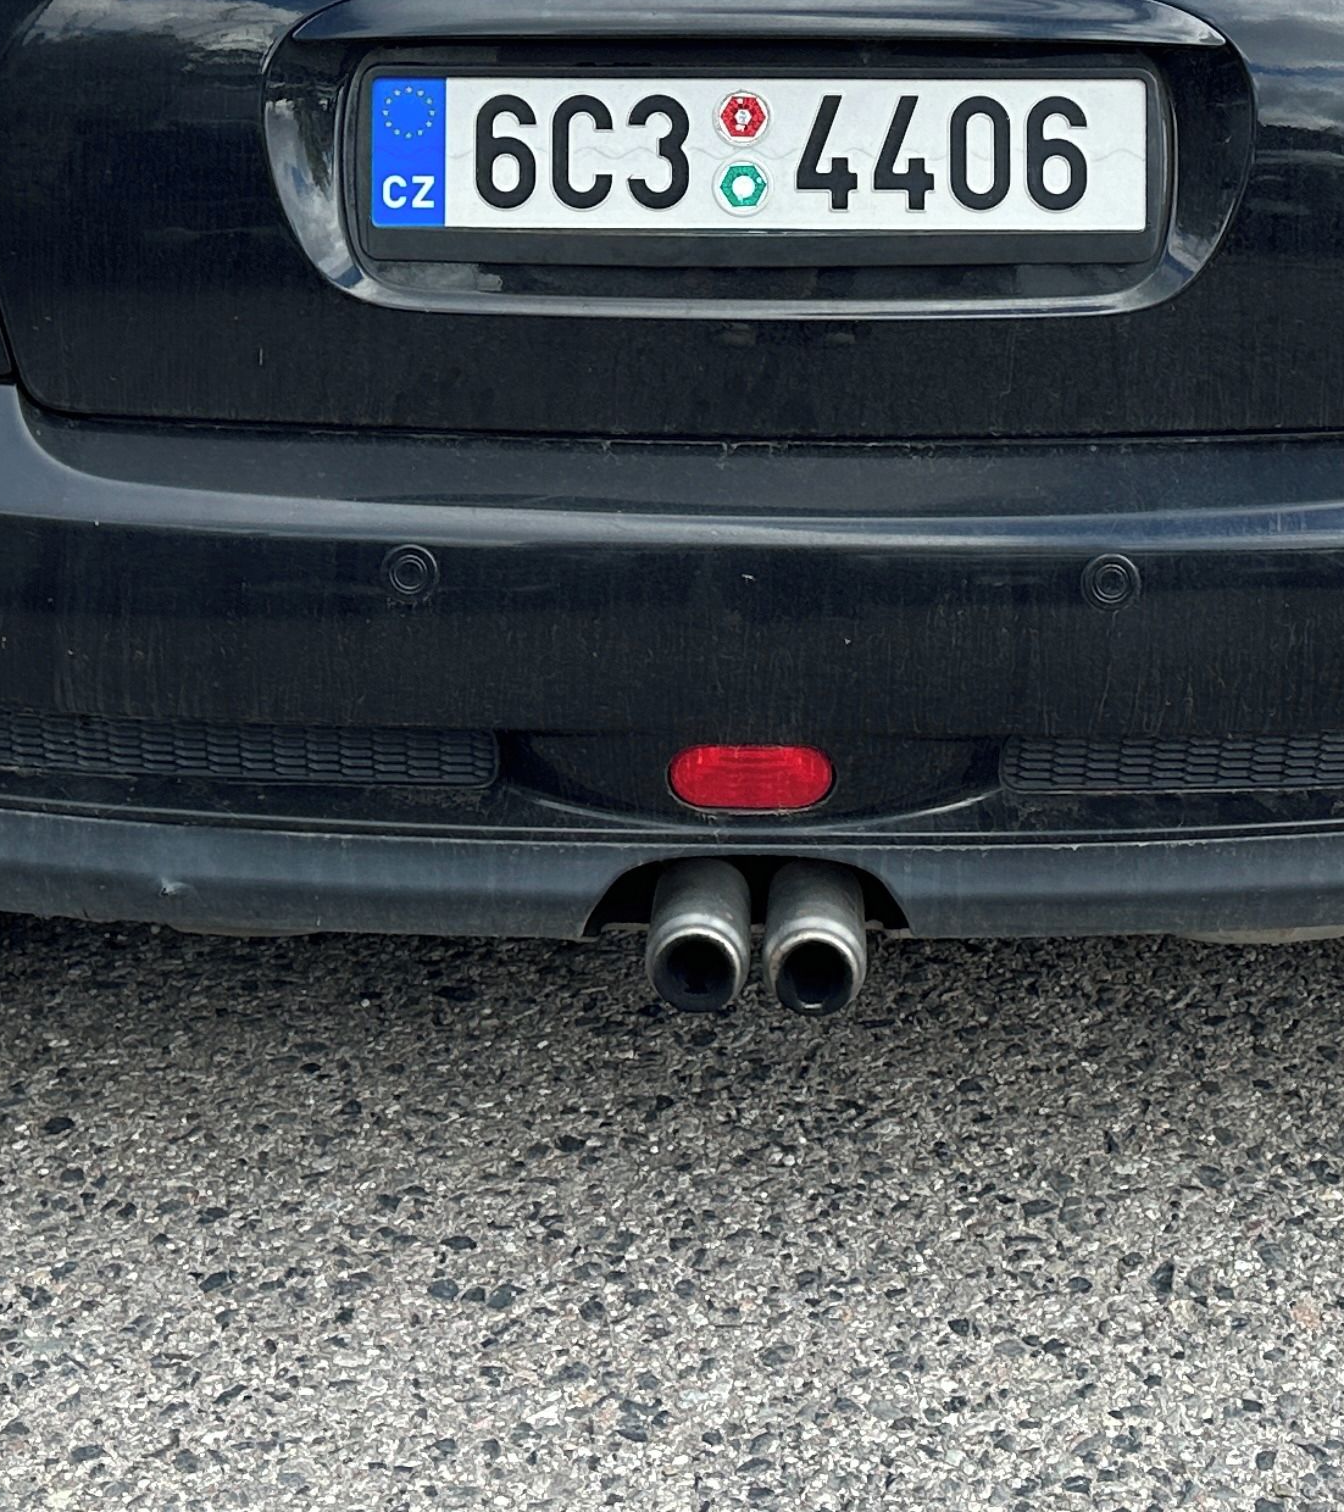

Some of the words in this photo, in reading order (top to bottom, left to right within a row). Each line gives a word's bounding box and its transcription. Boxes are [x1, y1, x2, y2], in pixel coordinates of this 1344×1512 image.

[476, 94, 690, 210] 6C3
[796, 94, 1088, 211] 4406
[382, 176, 435, 207] CZ
